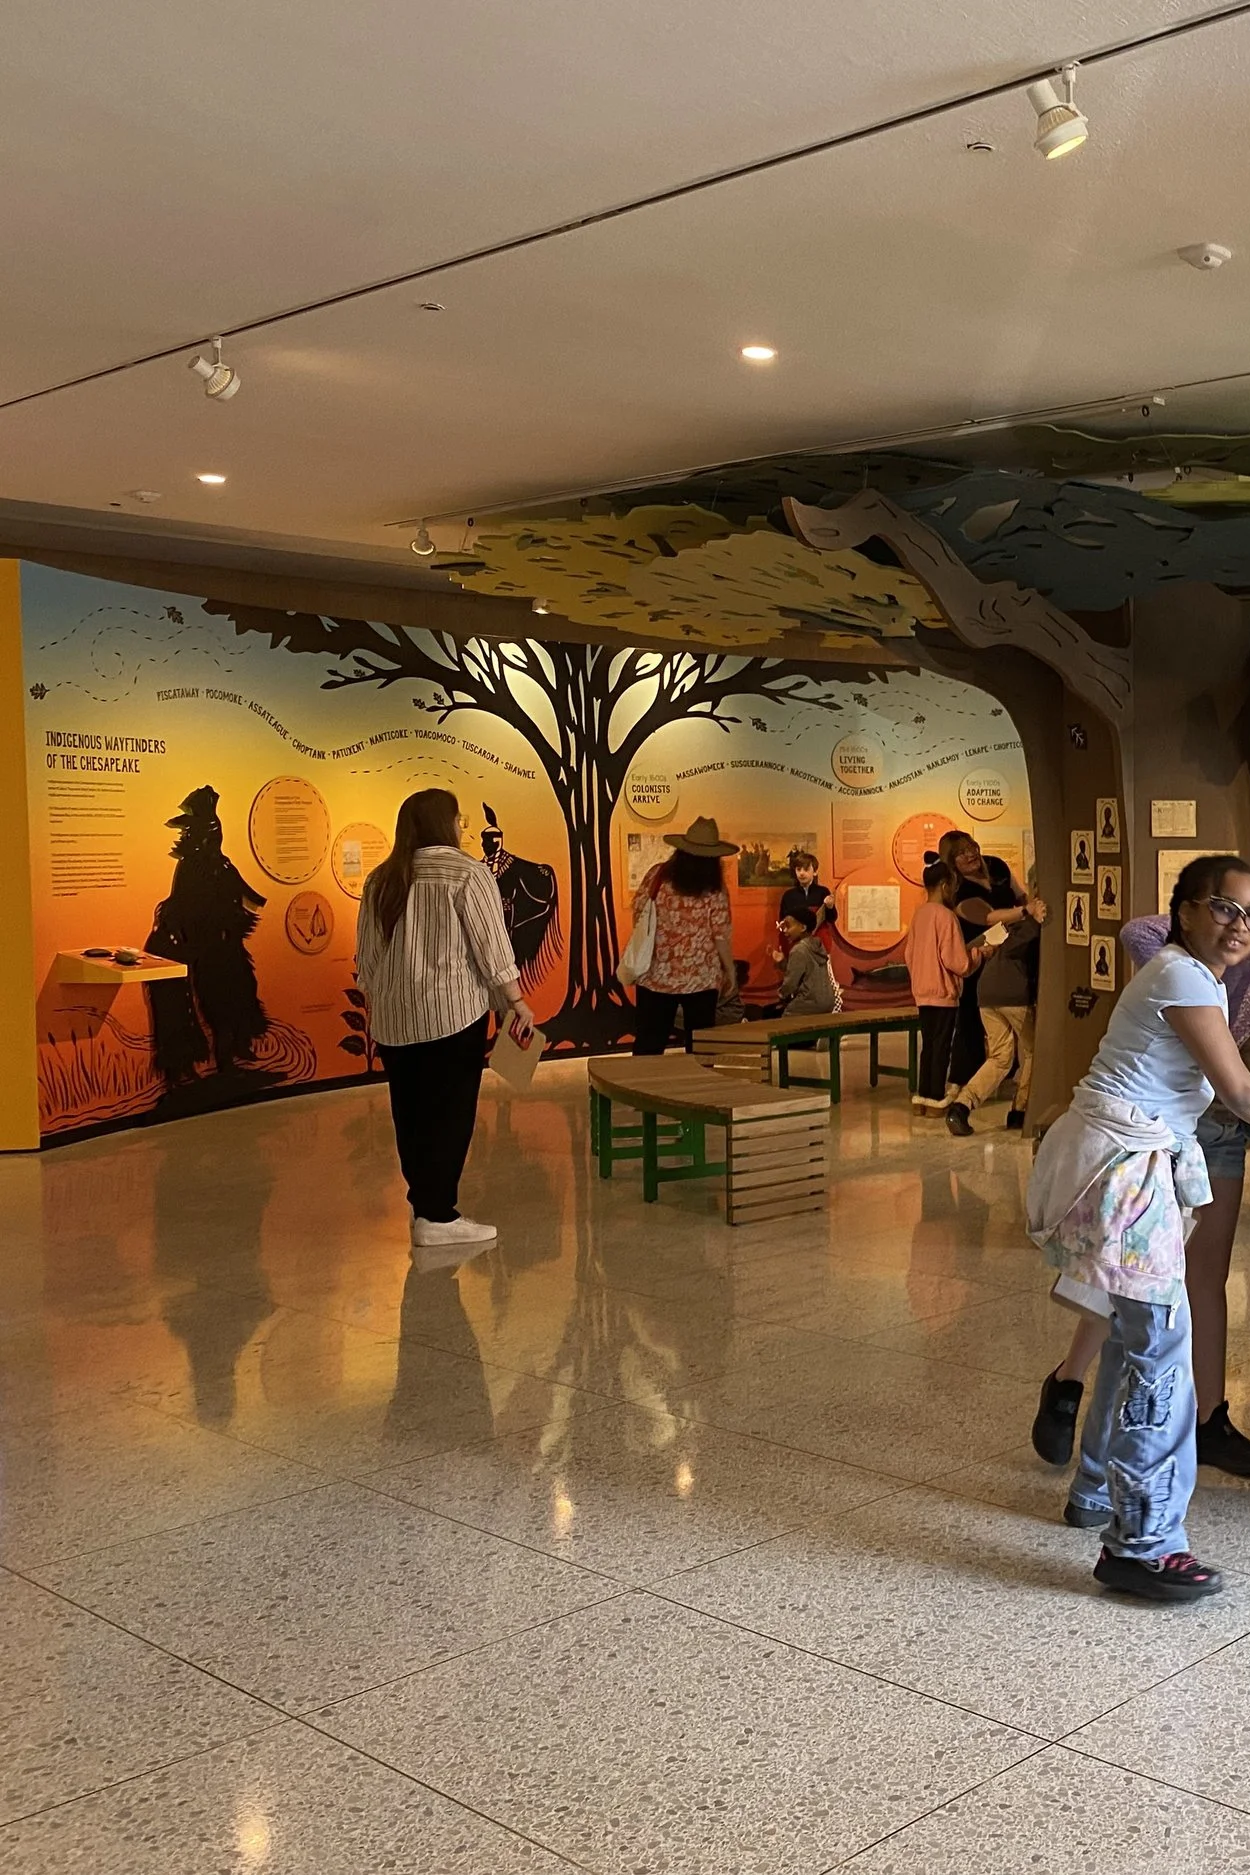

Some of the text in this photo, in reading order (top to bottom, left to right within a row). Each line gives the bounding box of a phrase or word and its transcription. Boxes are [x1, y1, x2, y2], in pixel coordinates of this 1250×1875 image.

[157, 688, 199, 701] PISCATAWAY
[205, 688, 243, 706] POCOMOKE
[248, 700, 289, 740] ASSATEAGUE
[292, 738, 326, 760] CHOPTANK
[369, 729, 408, 746] NANTICOKE
[414, 729, 456, 745] YOACOMOCO
[462, 740, 500, 765] TUSCARORA
[503, 762, 536, 780] SHAWNEE
[46, 730, 166, 754] INDIGENOUS WAYFINDERS
[46, 753, 140, 773] OF THE CHESAPEAKE
[839, 755, 866, 764] LIVING
[676, 761, 725, 781] MASSAWOMECK
[790, 767, 833, 791] NACOTCHTANK
[888, 769, 923, 790] ANACOSTAN
[926, 754, 960, 771] NANJEMOY
[965, 746, 989, 757] LENAPE
[840, 765, 874, 774] TOGETHER
[631, 784, 670, 794] COLONISTS
[966, 788, 1001, 796] ADAPTING
[632, 795, 660, 803] ARRIVE
[977, 798, 1003, 806] CHANGE
